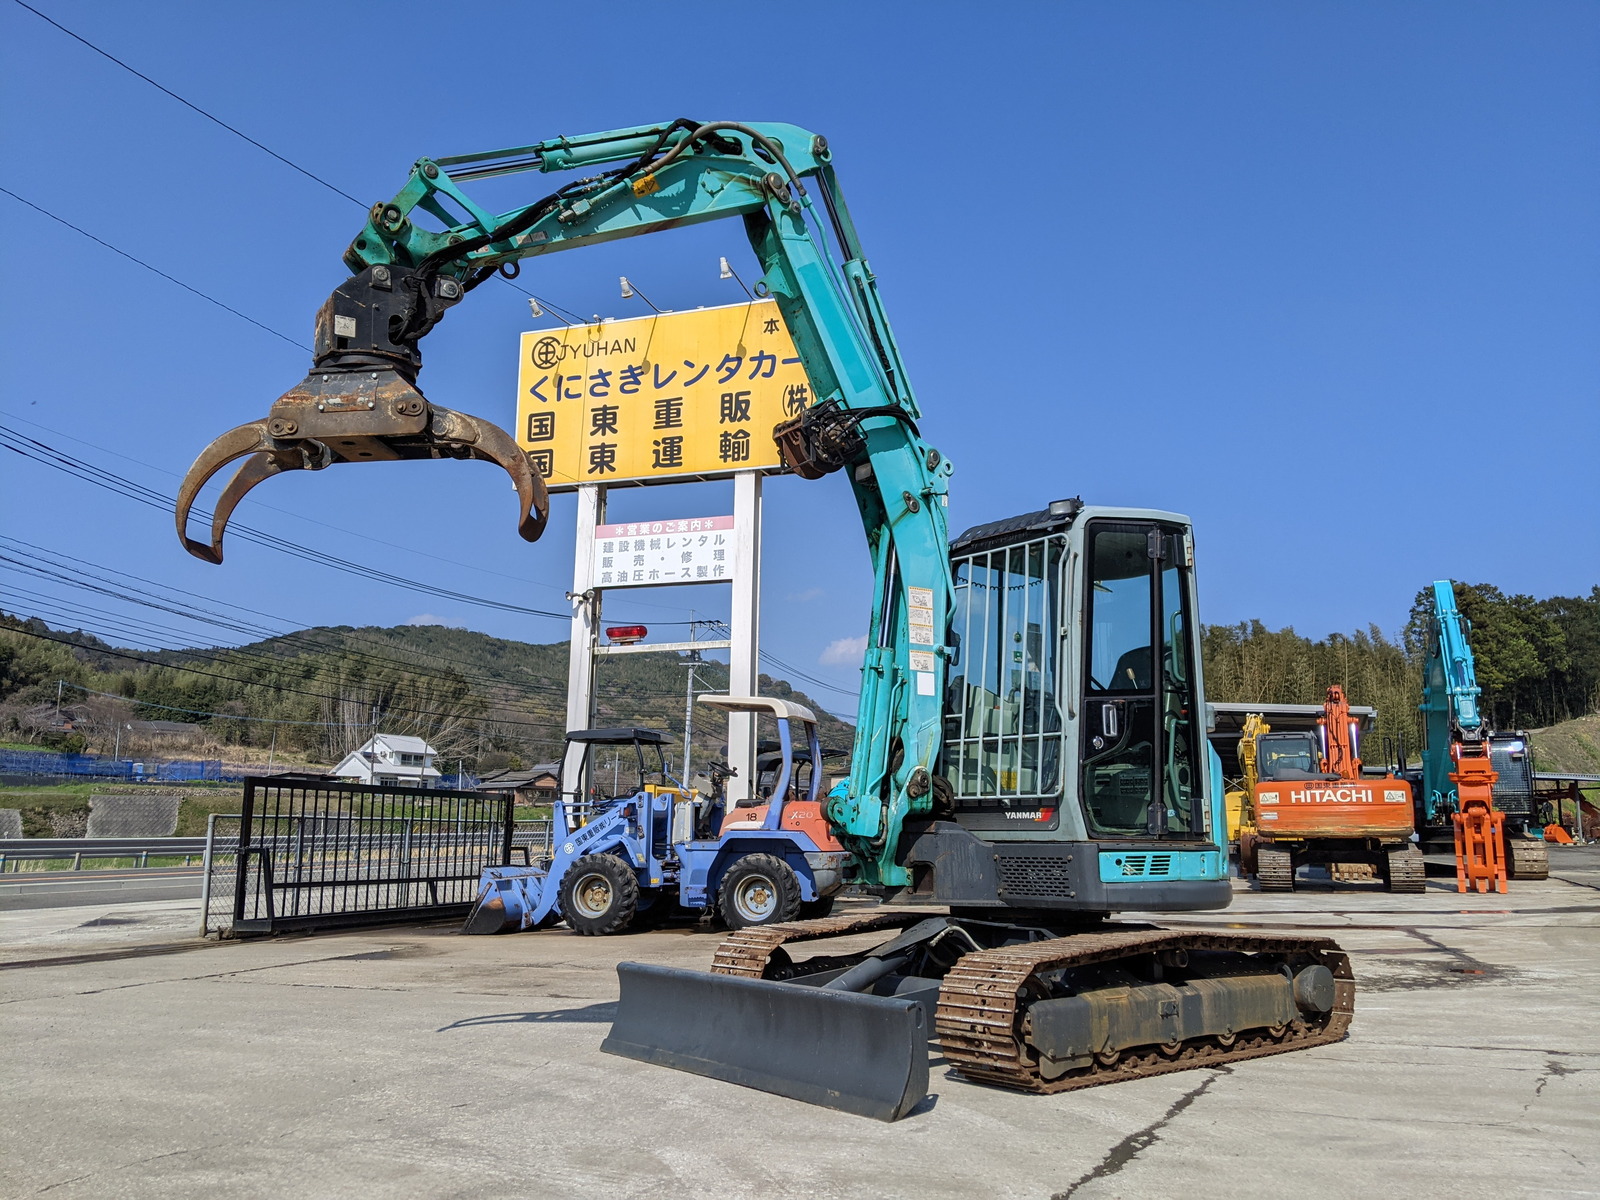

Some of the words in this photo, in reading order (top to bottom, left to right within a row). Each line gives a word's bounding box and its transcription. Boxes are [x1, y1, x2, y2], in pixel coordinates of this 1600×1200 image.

[556, 337, 636, 361] JYUHAN
[529, 350, 802, 402] くにさきレンタカー
[603, 534, 725, 554] 建設機械レンタル
[601, 564, 725, 584] 高油圧ホース製作
[1291, 789, 1373, 804] HITACHI
[745, 812, 758, 821] 18
[1005, 811, 1042, 819] YANMAR
